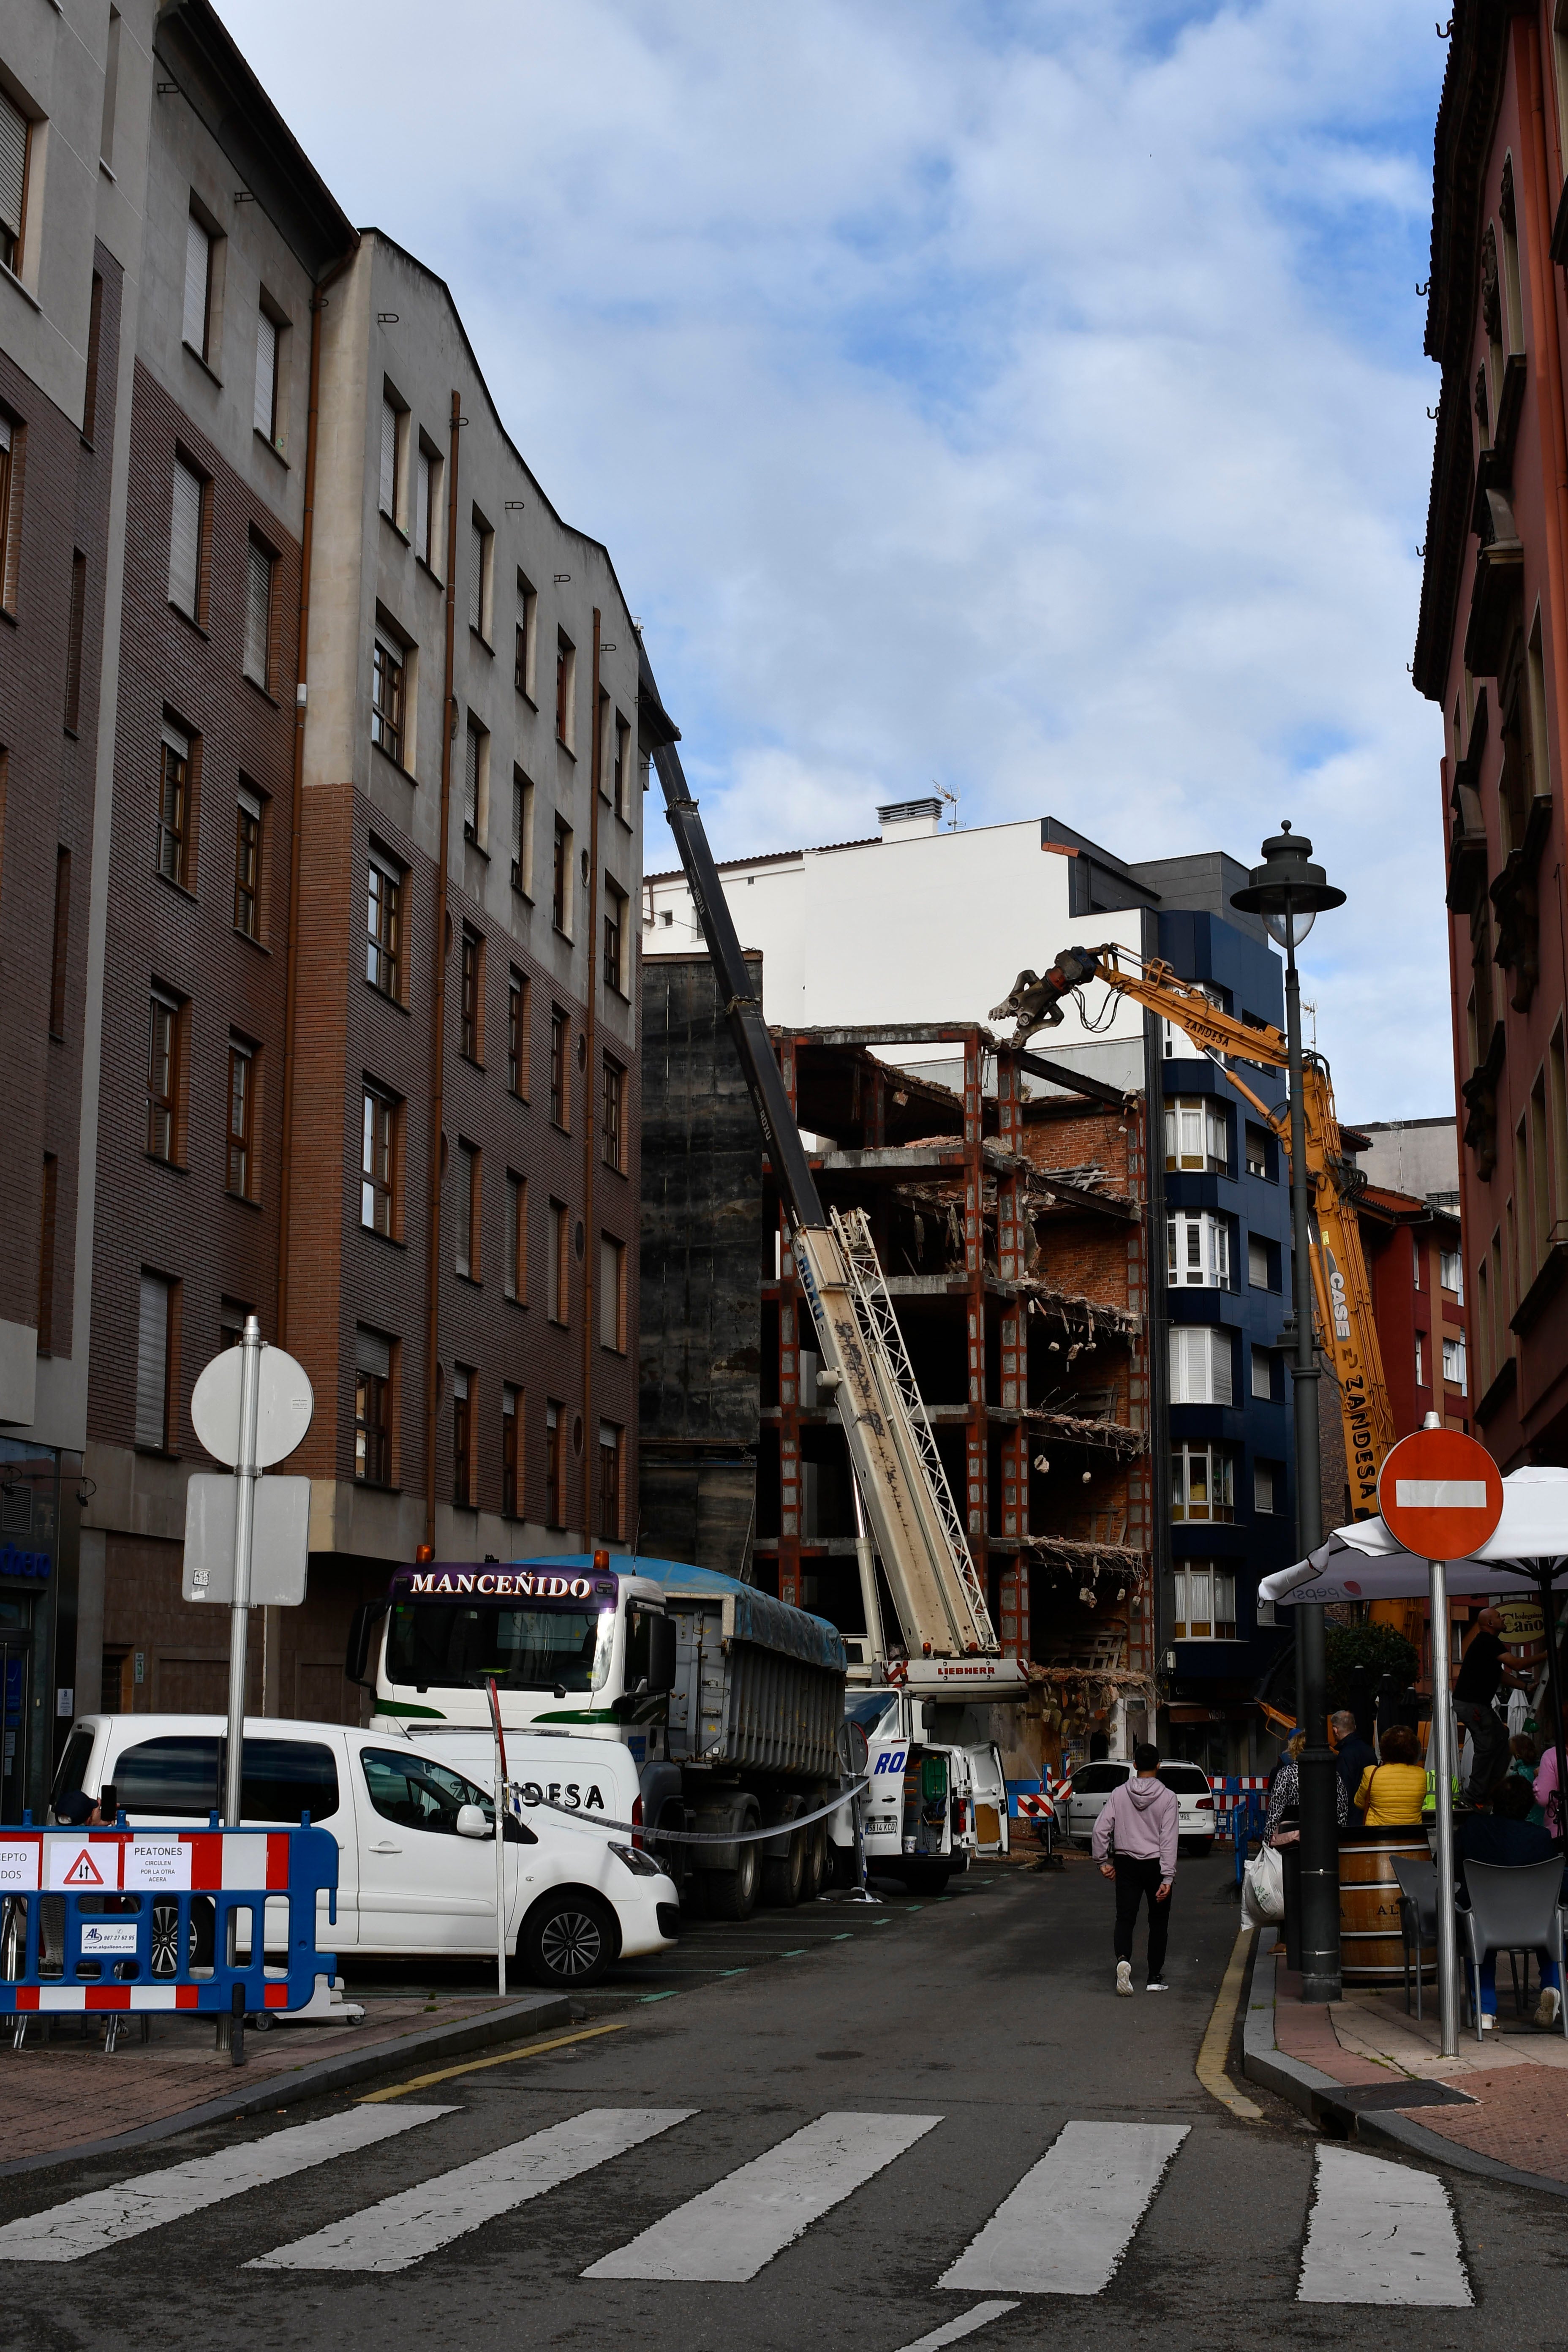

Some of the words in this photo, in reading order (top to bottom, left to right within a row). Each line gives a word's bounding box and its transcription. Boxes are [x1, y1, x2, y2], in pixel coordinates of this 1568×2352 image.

[694, 887, 706, 915] ROXU
[1184, 1018, 1230, 1047] ZANDESA
[760, 1109, 773, 1141] ROXU
[799, 1255, 824, 1321] ROXU
[1330, 1271, 1351, 1337] CASE
[1345, 1374, 1377, 1499] ZANDESA
[410, 1571, 592, 1599] MANCEÑIDO
[938, 1667, 995, 1675] LIEBHERR
[884, 1823, 895, 1831] KCD
[0, 1853, 27, 1862] EPTO
[134, 1847, 182, 1856] PEATONES
